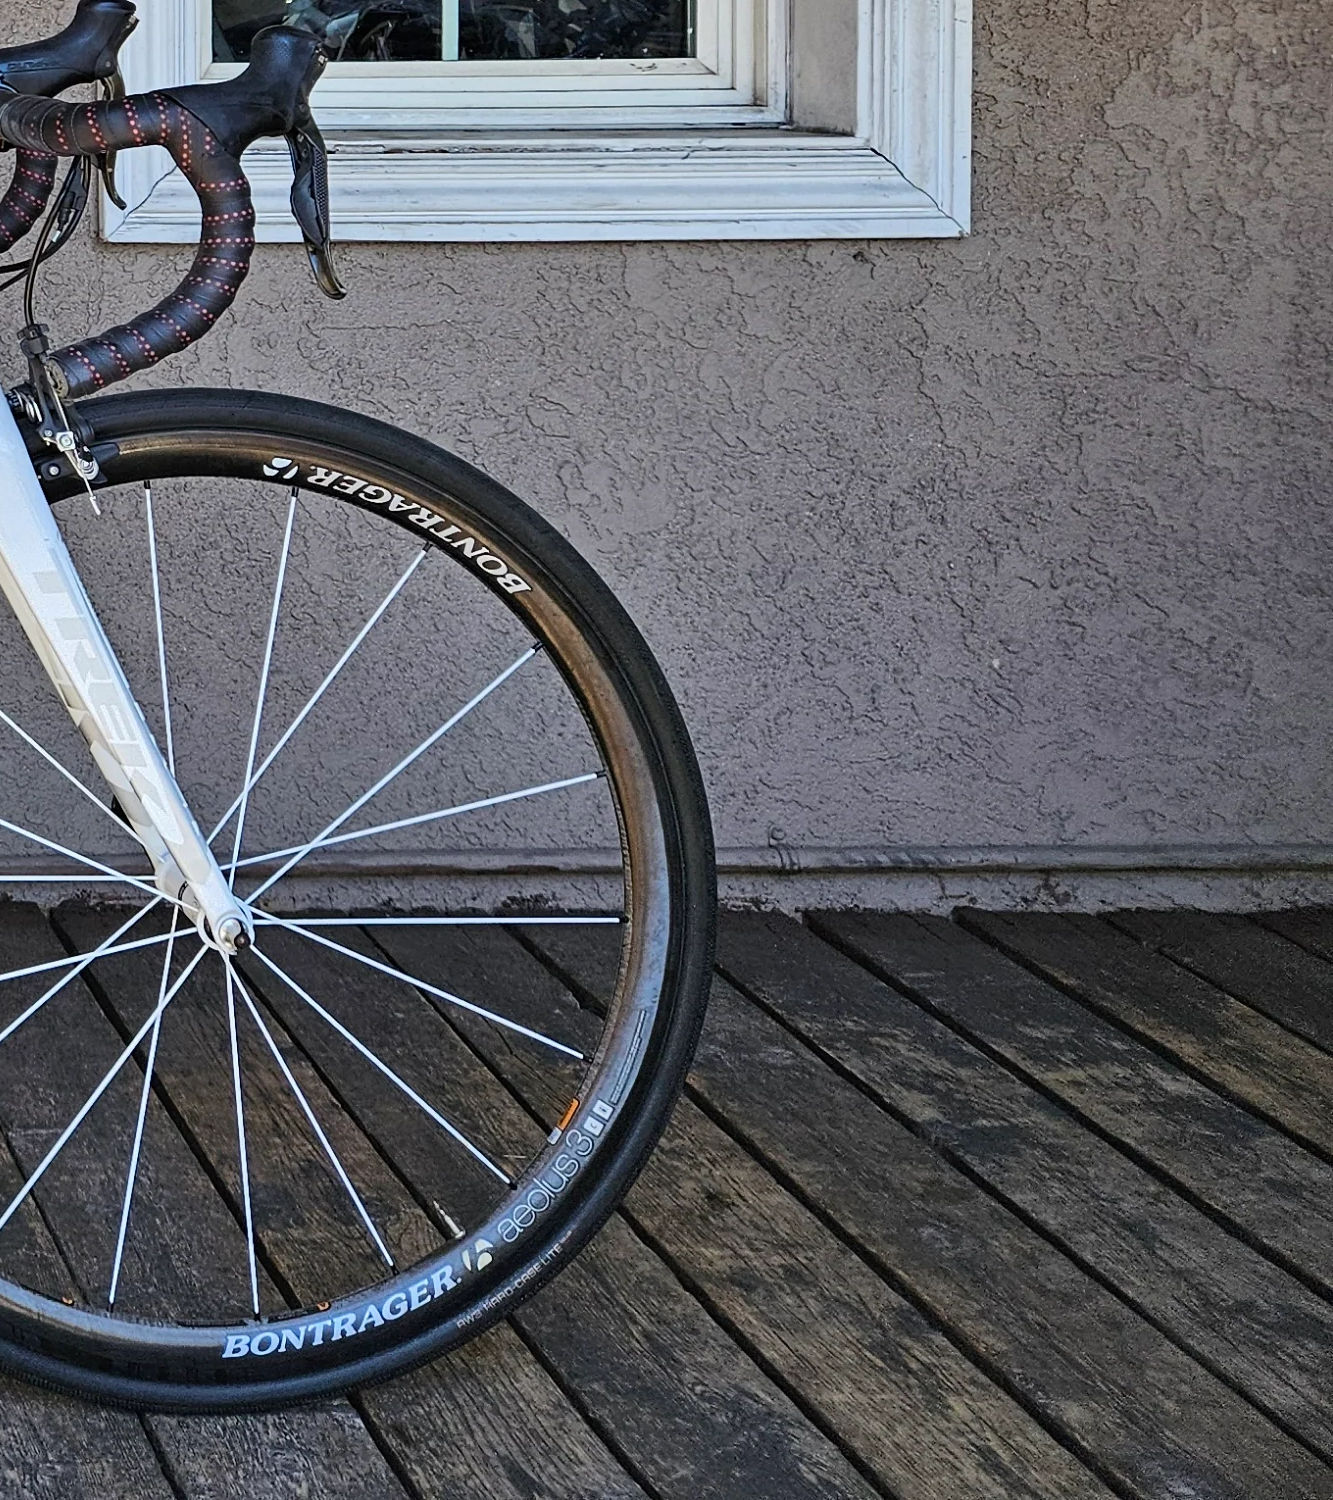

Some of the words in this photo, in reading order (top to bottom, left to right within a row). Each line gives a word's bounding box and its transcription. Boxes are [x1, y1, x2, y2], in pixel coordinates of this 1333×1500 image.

[497, 1153, 579, 1243] aeolus
[565, 1127, 595, 1157] 3
[482, 1261, 543, 1312] HARD-CASE
[540, 1243, 563, 1269] LITE
